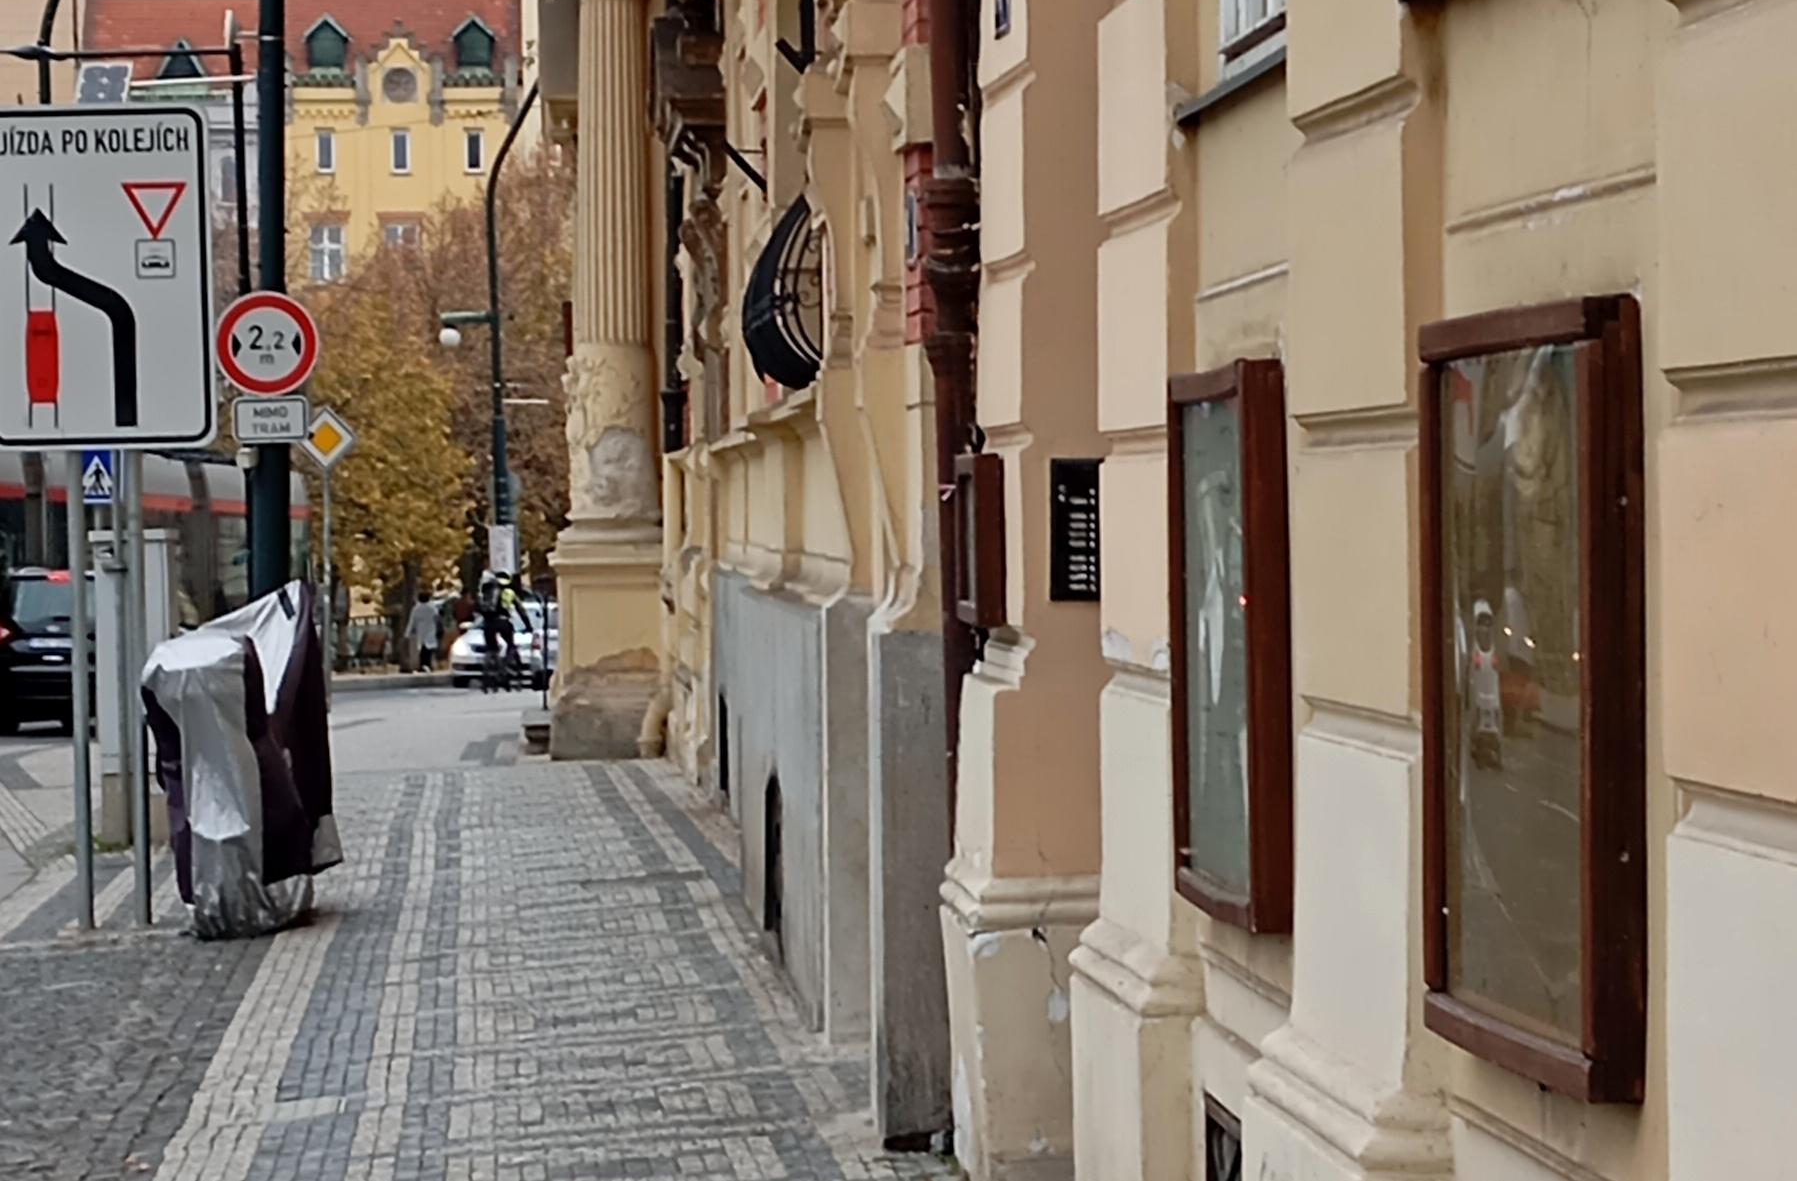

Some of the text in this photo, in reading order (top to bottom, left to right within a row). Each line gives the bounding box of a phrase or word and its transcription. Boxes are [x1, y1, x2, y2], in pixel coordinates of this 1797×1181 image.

[62, 129, 87, 153] PO
[94, 122, 189, 153] KOLEJÍCH
[259, 353, 275, 364] m
[252, 406, 289, 419] MIMO
[251, 422, 291, 435] TRAM
